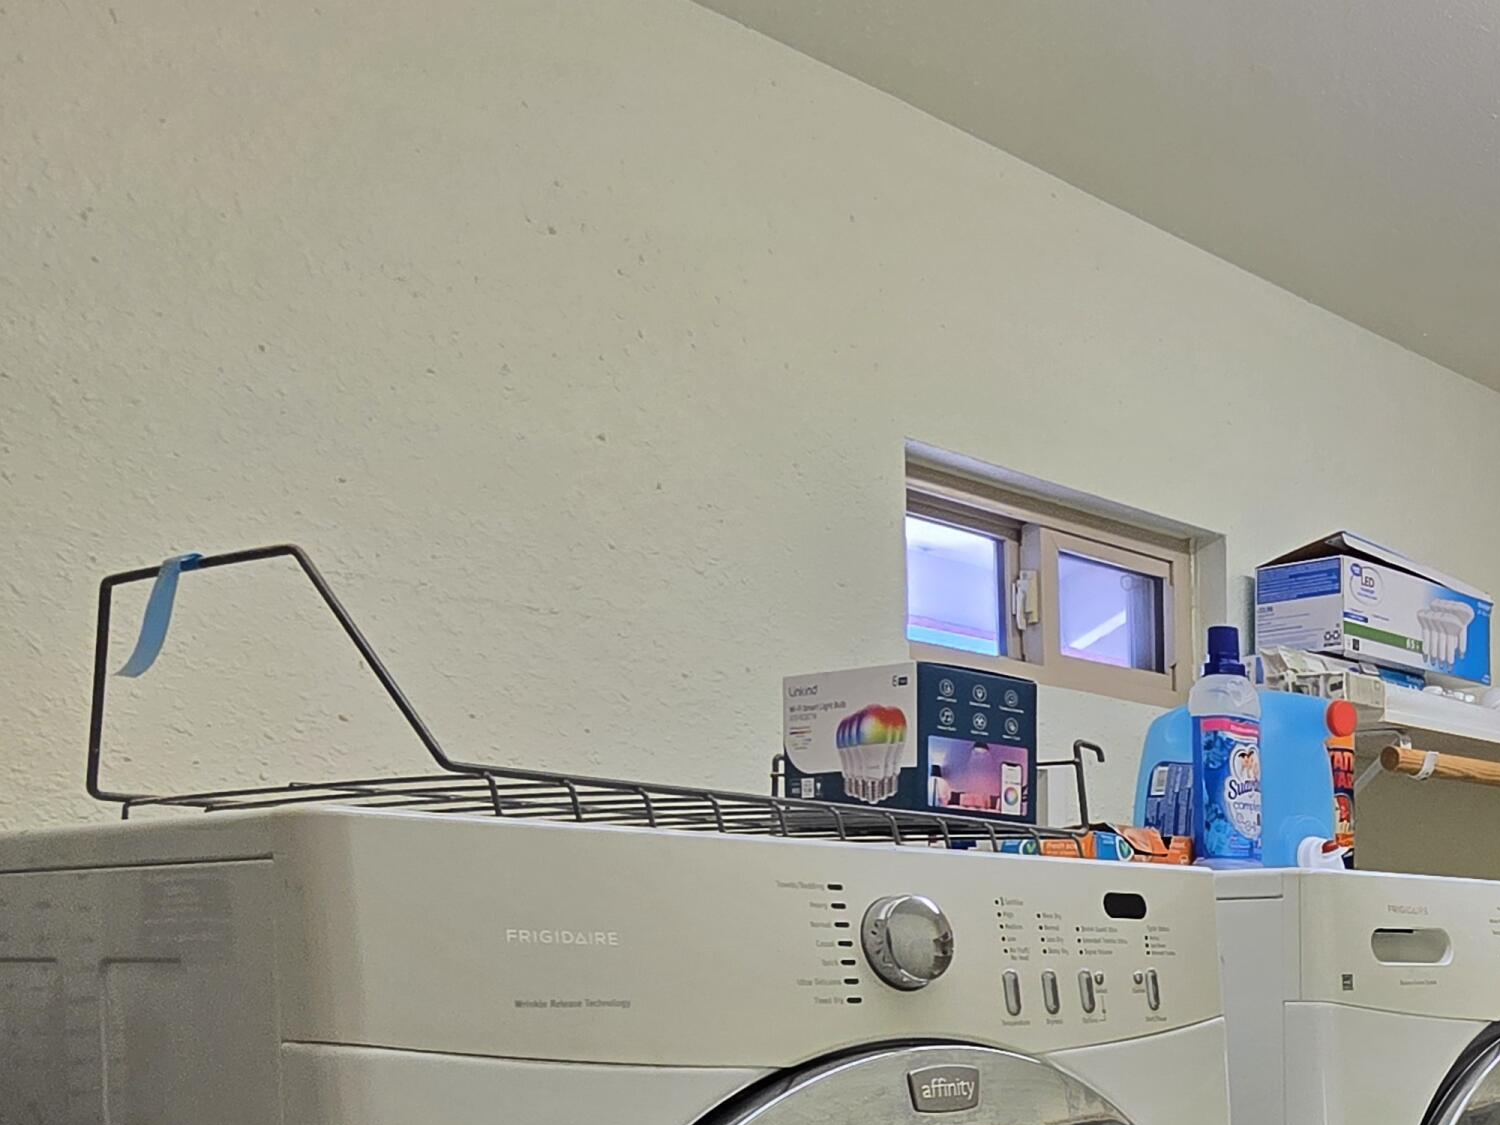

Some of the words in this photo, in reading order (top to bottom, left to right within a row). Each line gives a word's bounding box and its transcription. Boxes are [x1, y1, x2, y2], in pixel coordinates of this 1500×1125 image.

[1361, 575, 1375, 588] LED
[506, 928, 620, 946] FRIGIDAIRE
[921, 1076, 975, 1100] affinity
